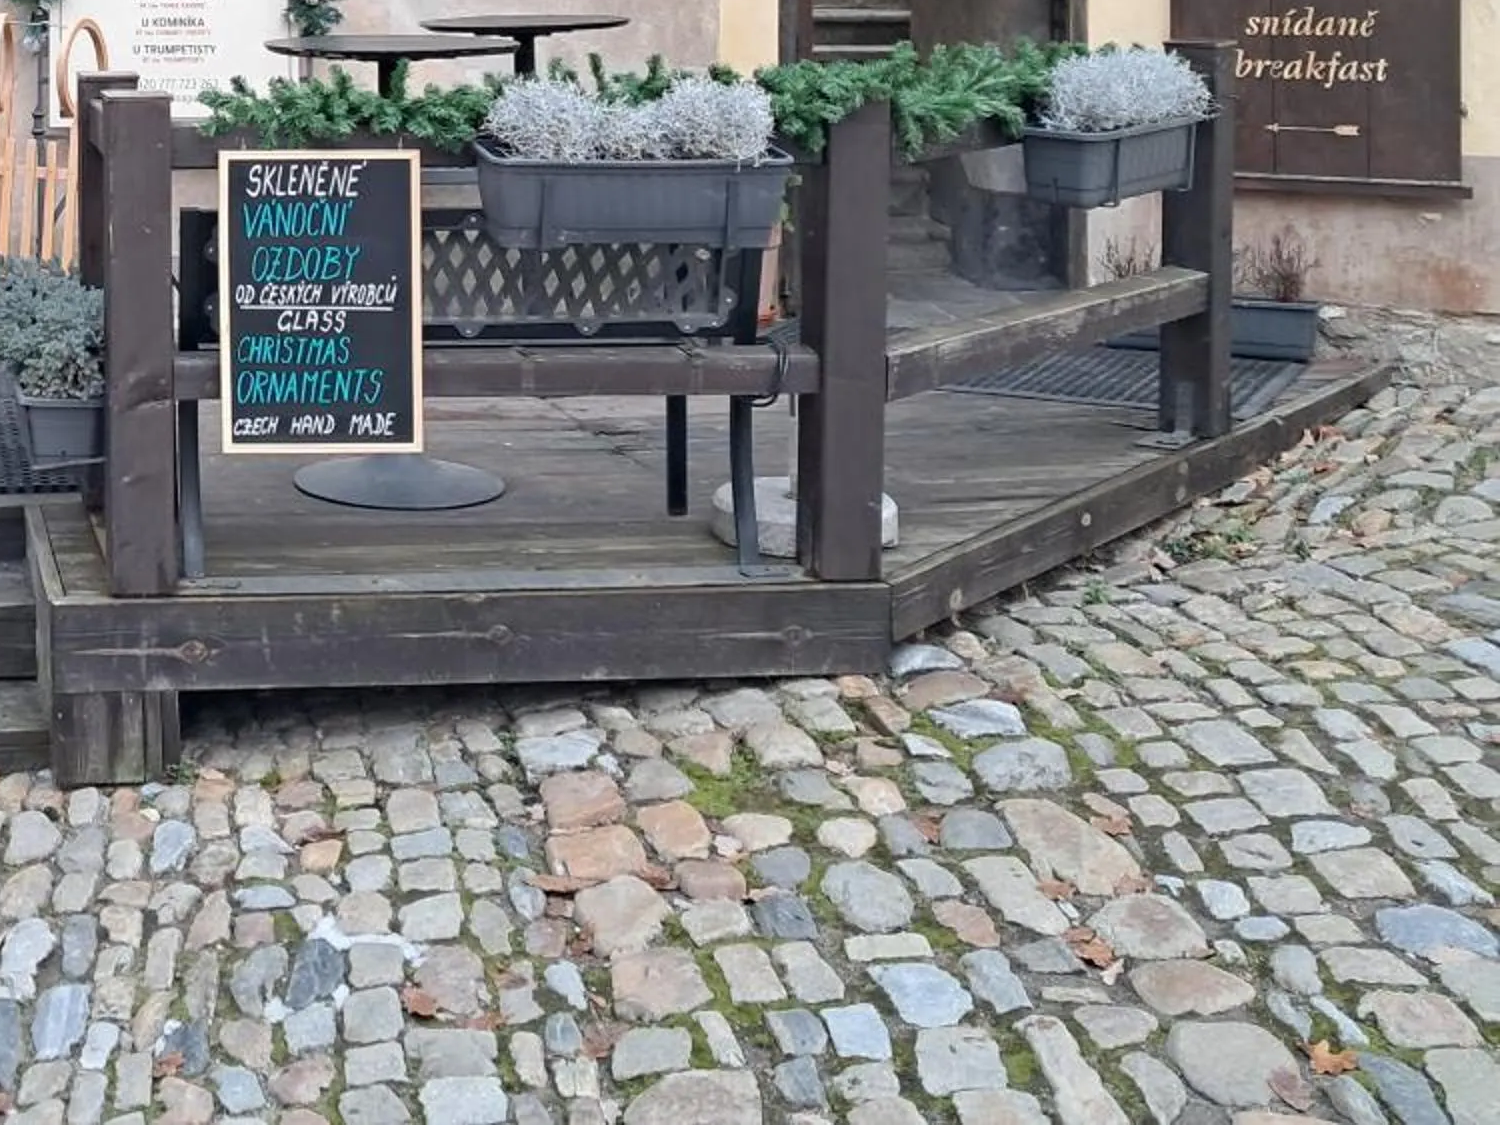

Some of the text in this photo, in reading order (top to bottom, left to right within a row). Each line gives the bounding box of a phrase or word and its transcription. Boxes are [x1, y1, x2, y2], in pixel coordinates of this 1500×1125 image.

[1245, 6, 1380, 37] snídaně
[144, 44, 216, 55] TRUMPETISTY
[1234, 48, 1389, 89] breakfast
[245, 161, 367, 197] SKLENĚNÉ
[243, 198, 353, 240] VÁNOČNÍ
[252, 244, 361, 282] OZDOBY
[235, 275, 398, 306] OD ČESKÝCH VÝROBCŮ
[277, 310, 347, 333] GLASS
[237, 334, 351, 365] CHRISTMAS
[237, 369, 383, 404] ORNAMENTS
[233, 412, 397, 436] CZECH HAND MADE
